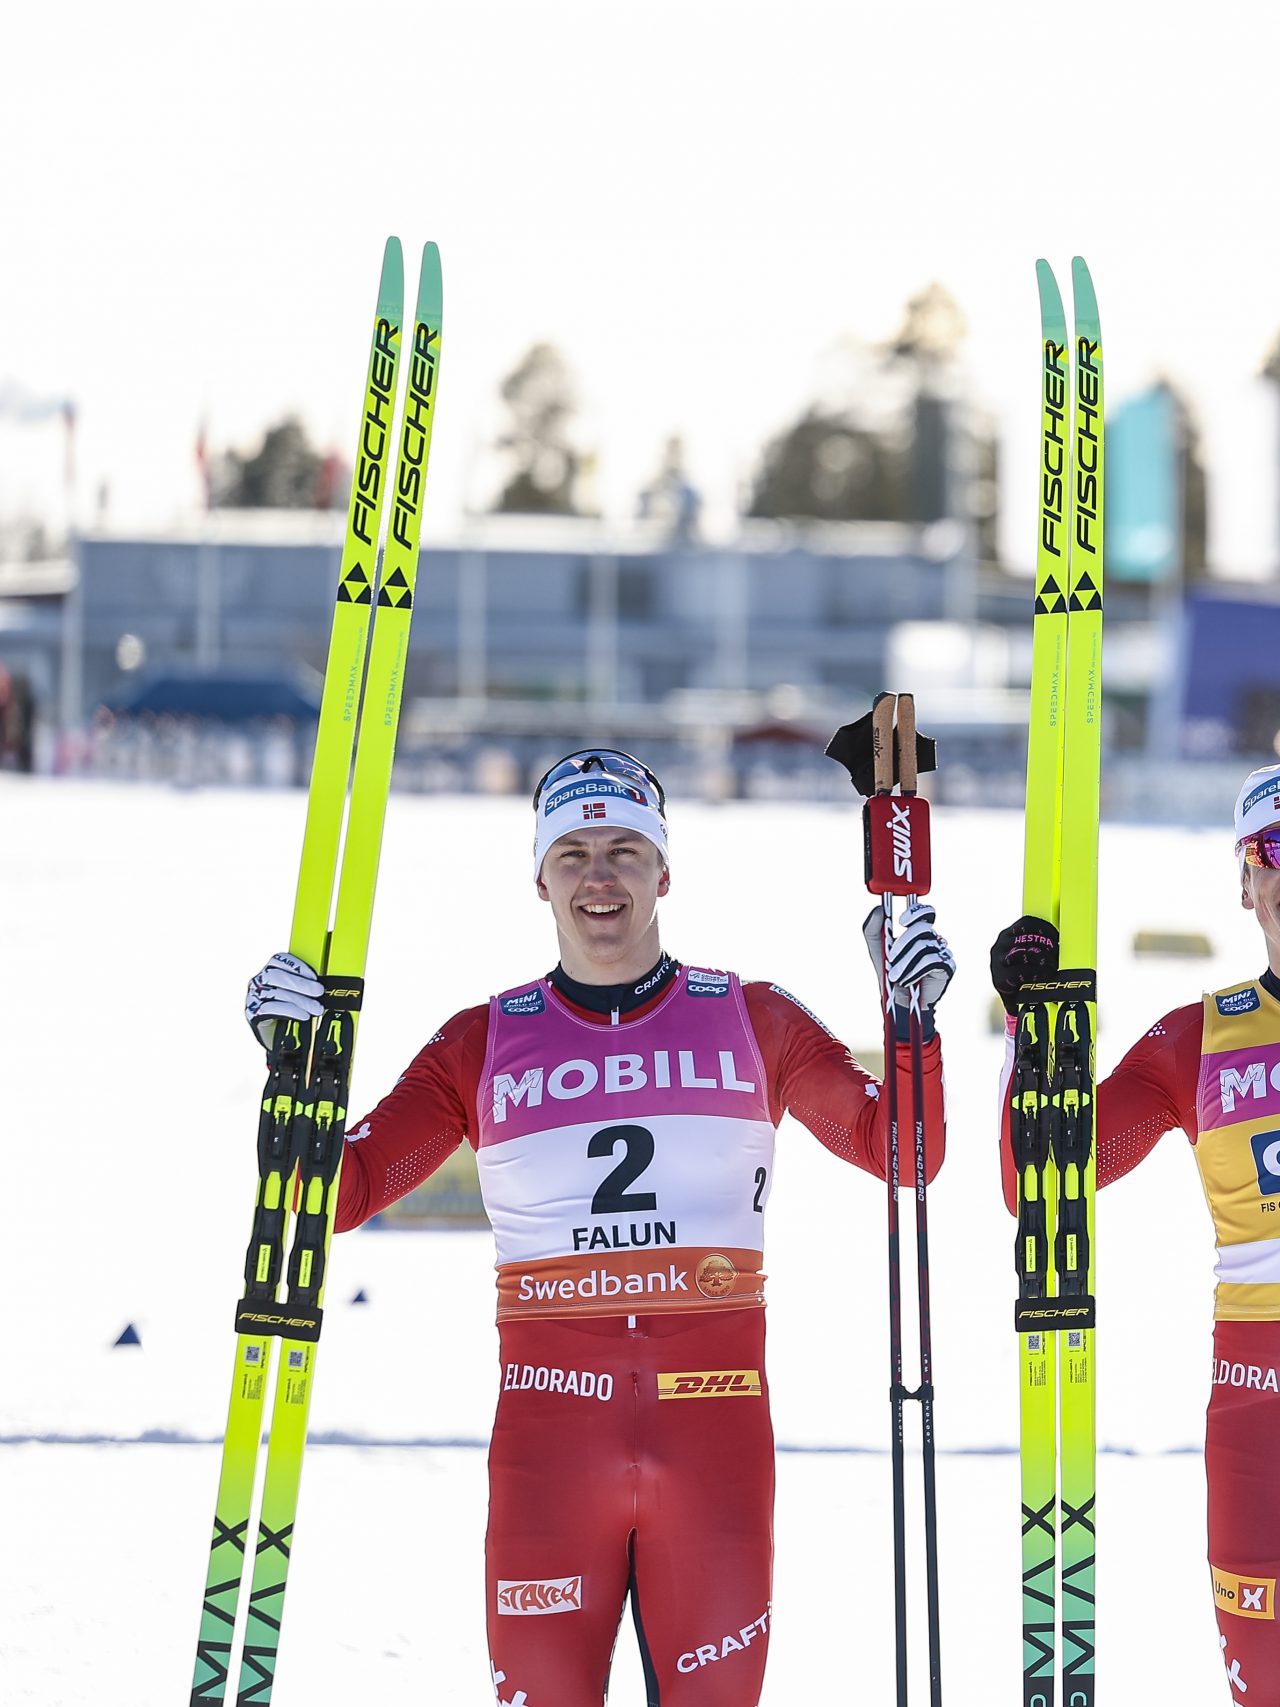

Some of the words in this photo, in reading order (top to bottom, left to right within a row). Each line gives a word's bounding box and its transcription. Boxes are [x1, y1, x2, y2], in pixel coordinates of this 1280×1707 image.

[352, 318, 399, 546] FISCHER
[393, 322, 438, 551] FISCHER
[1077, 336, 1098, 555] FISCHER
[1042, 339, 1065, 558] FISCHER
[545, 783, 627, 810] SpareBank
[1014, 935, 1054, 949] HESTRA
[634, 967, 665, 995] CRAFT
[688, 985, 727, 994] coop
[1019, 980, 1092, 991] FISCHER
[1224, 1001, 1253, 1011] coop
[492, 1050, 756, 1124] MOBILL
[587, 1124, 657, 1215] 2
[753, 1166, 767, 1213] 2
[917, 1170, 925, 1202] AERO
[1261, 1202, 1276, 1213] FIS
[572, 1221, 676, 1251] FALUN
[517, 1265, 688, 1301] Swedbank
[239, 1313, 316, 1328] FISCHER
[1019, 1308, 1089, 1319] FISCHER
[504, 1363, 614, 1402] ELDORADO
[674, 1375, 752, 1394] DHL
[498, 1577, 580, 1611] STAYER
[1215, 1581, 1235, 1601] Uno
[1241, 1587, 1264, 1610] X
[676, 1612, 769, 1674] CRAFT
